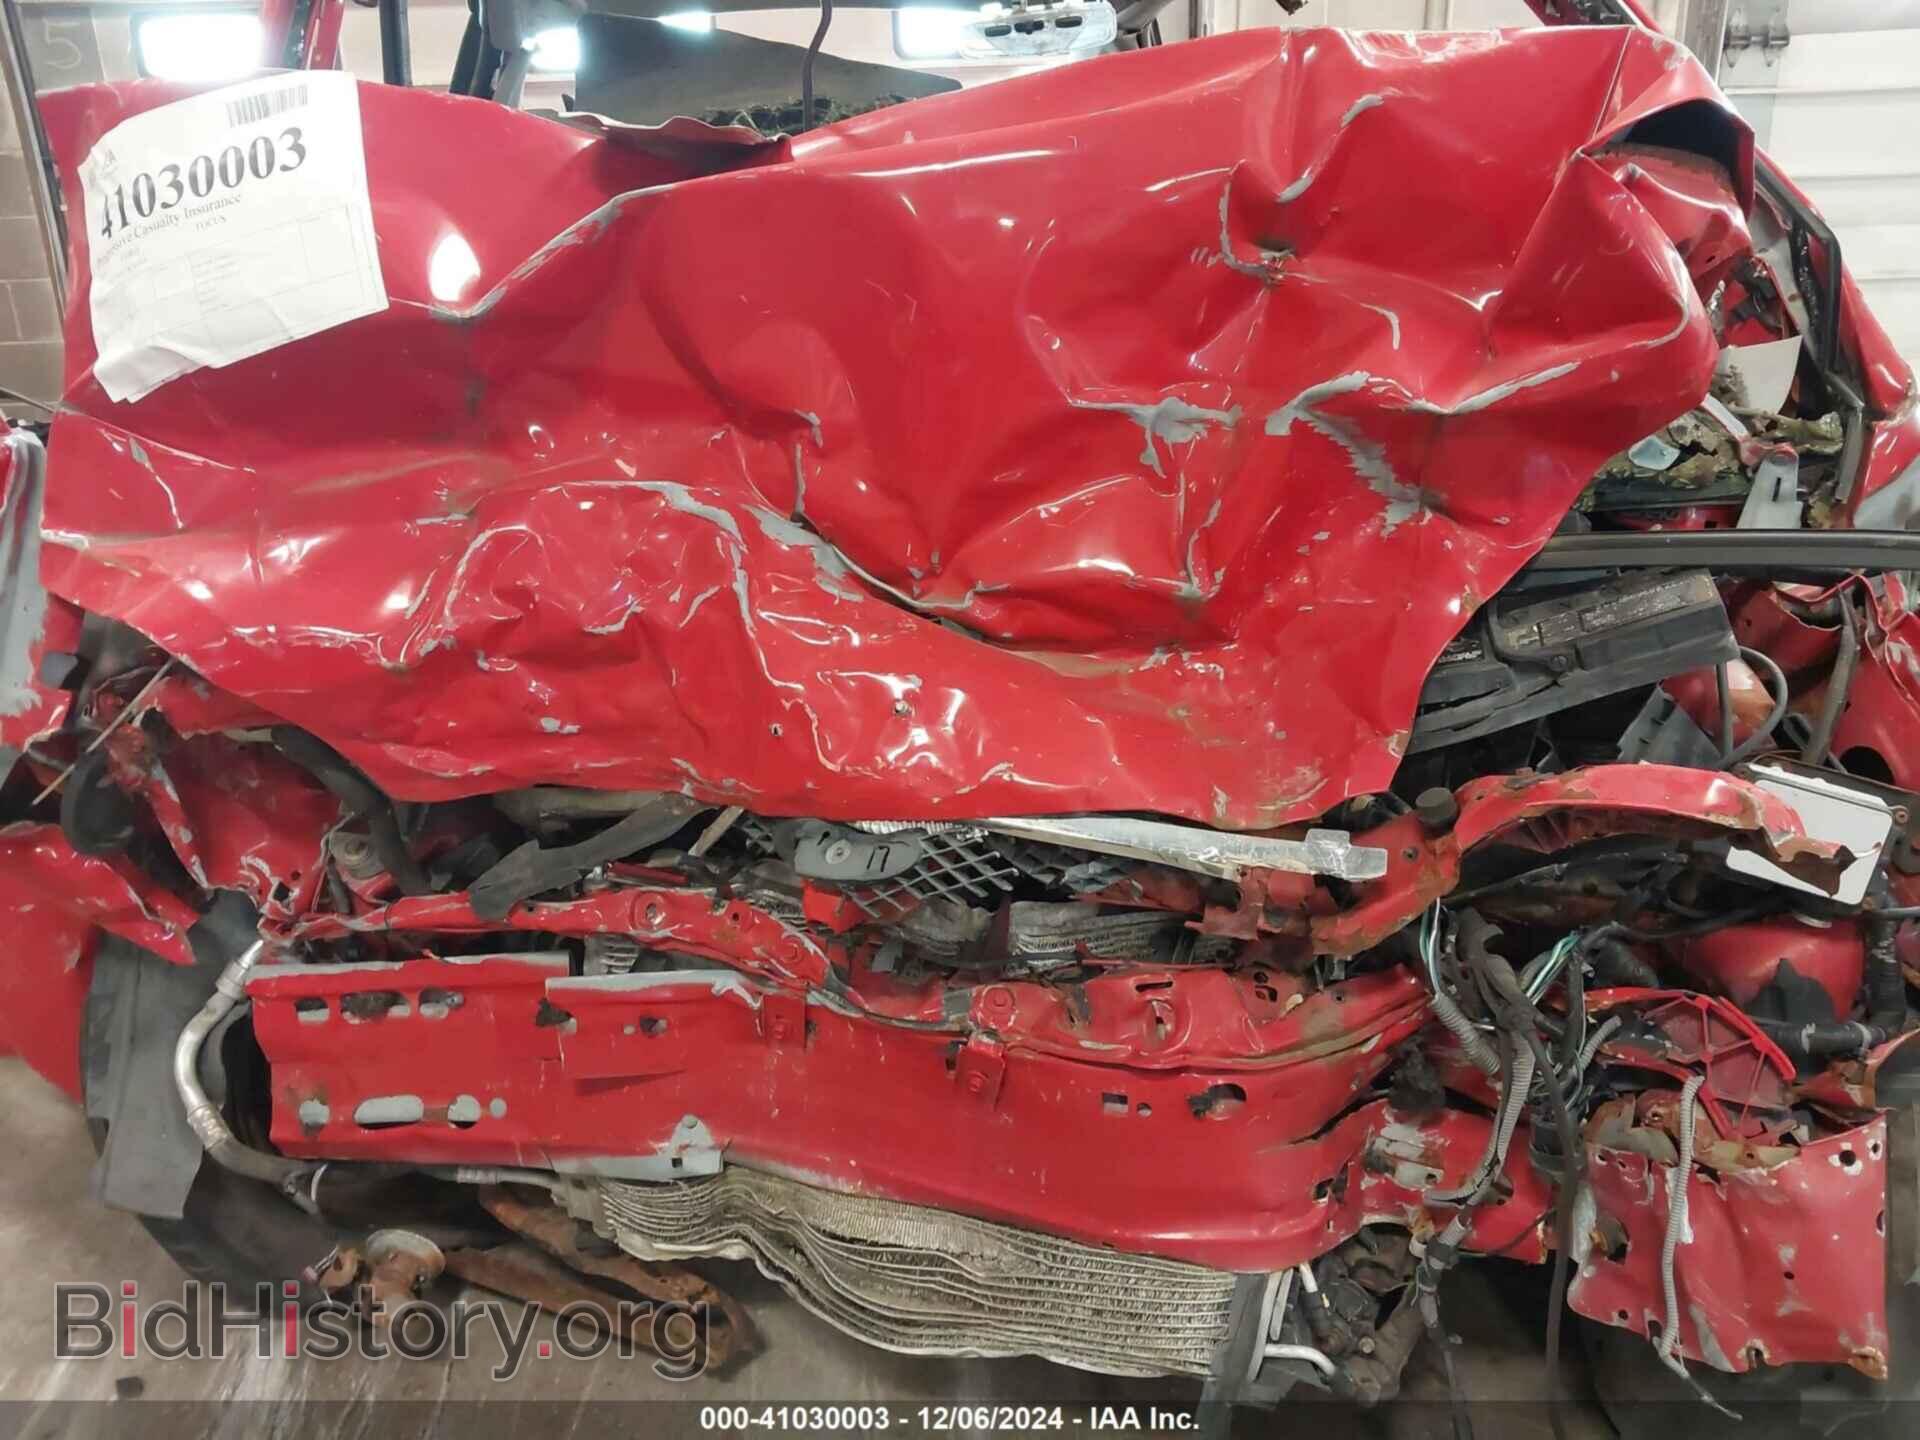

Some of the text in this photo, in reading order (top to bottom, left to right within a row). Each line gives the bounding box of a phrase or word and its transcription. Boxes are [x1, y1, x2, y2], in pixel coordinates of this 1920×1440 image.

[42, 19, 82, 69] 5
[101, 126, 308, 240] 41030003
[133, 193, 242, 240] Casualty Insurance
